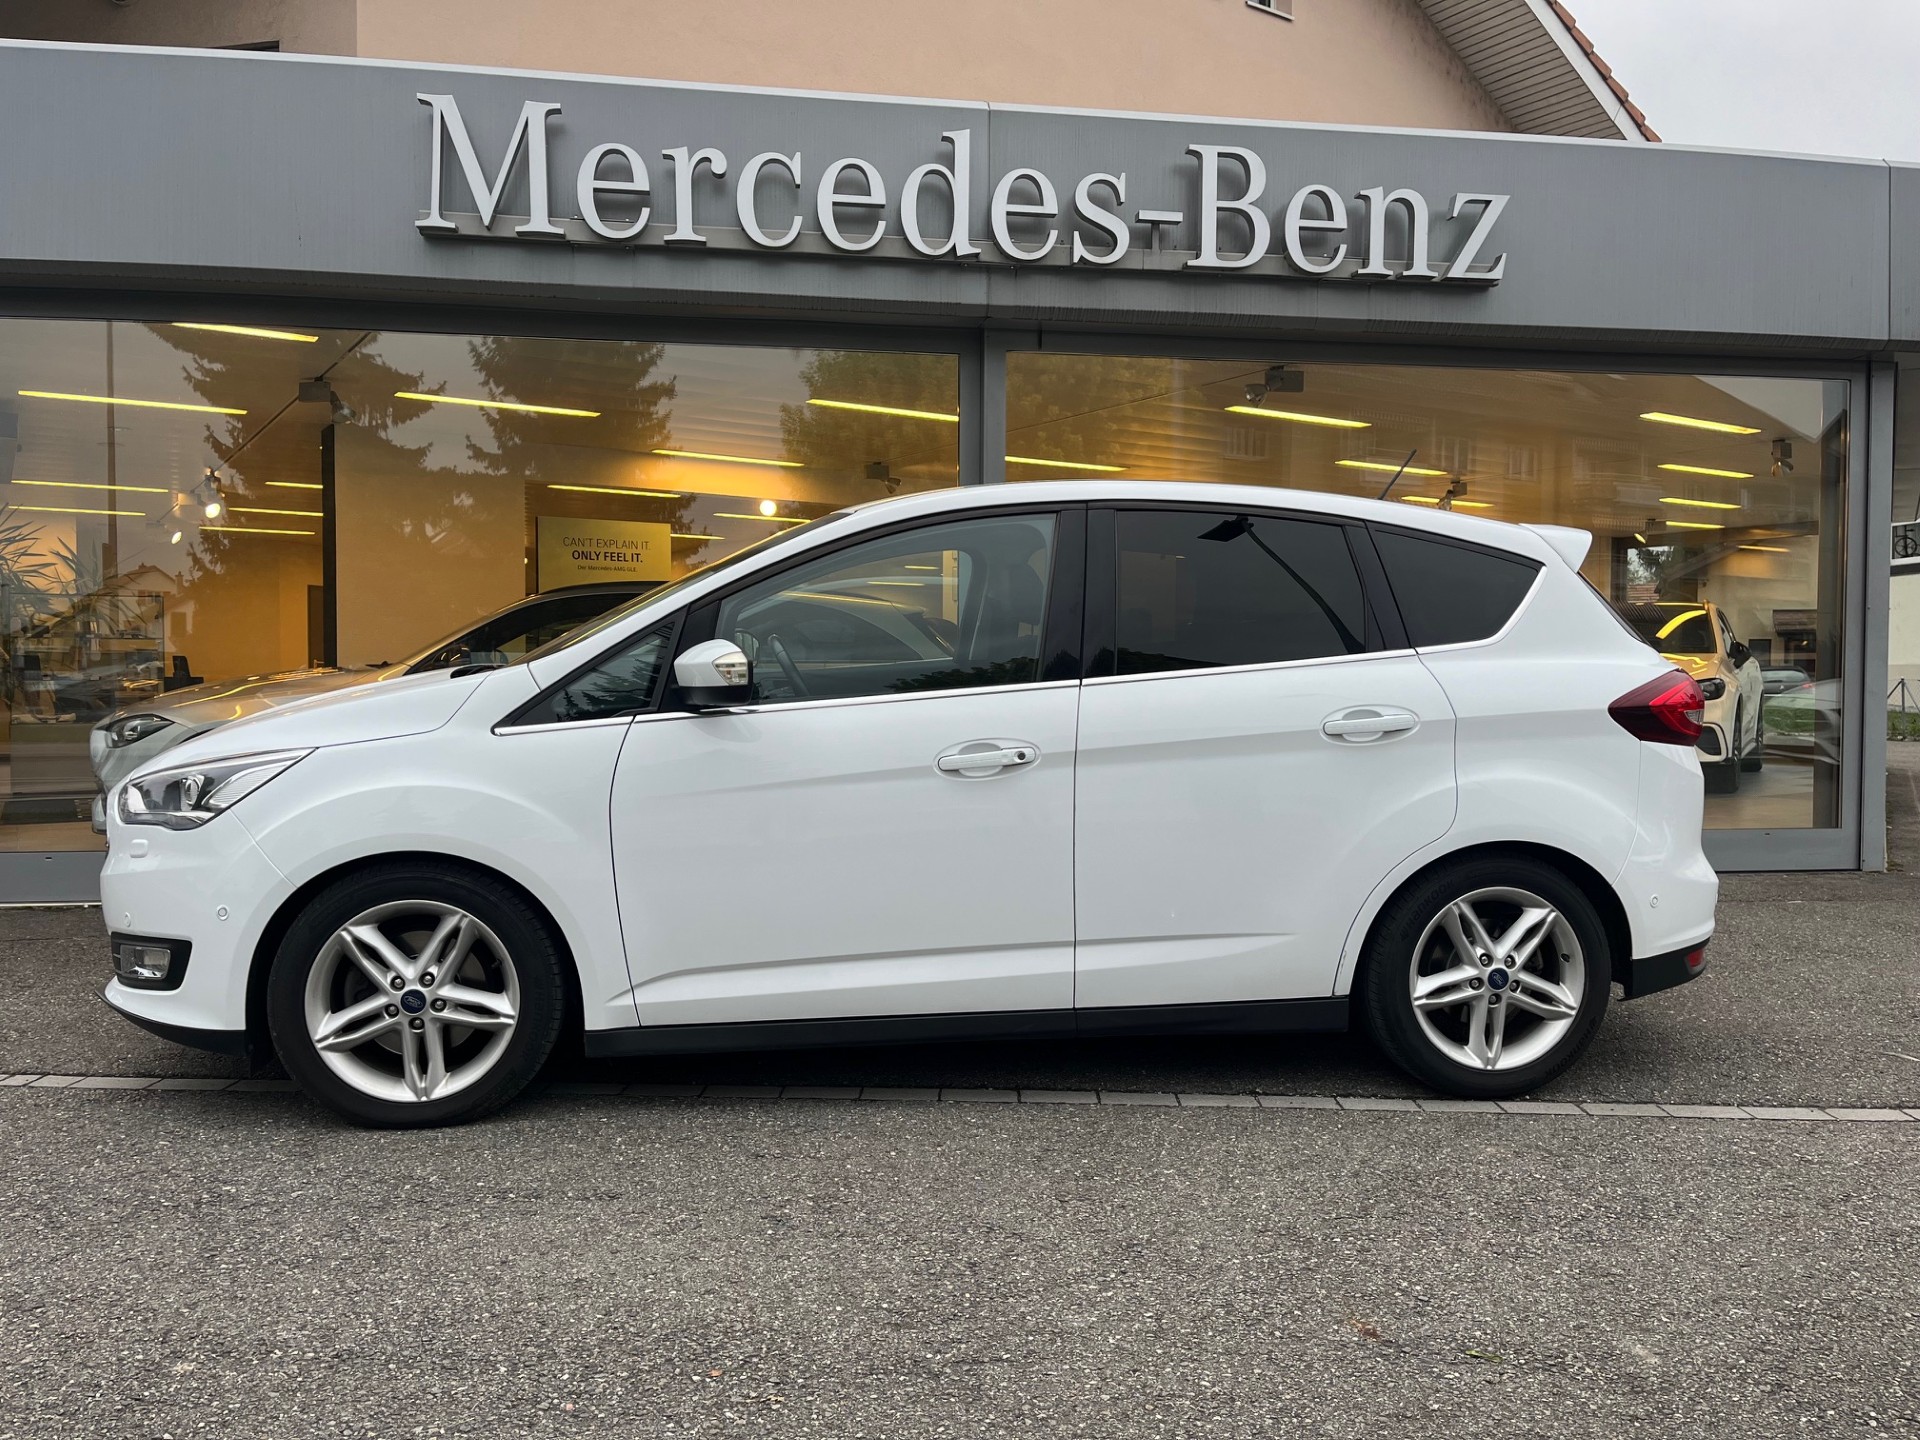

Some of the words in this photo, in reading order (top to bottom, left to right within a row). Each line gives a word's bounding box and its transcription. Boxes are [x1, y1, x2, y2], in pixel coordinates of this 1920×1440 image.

[414, 92, 1511, 282] Mercedes-Benz
[562, 536, 593, 547] CAN'T
[596, 538, 638, 550] EXPLAIN
[641, 541, 651, 550] IT.
[572, 550, 601, 560] ONLY
[604, 552, 629, 562] FEEL
[631, 553, 643, 563] IT.
